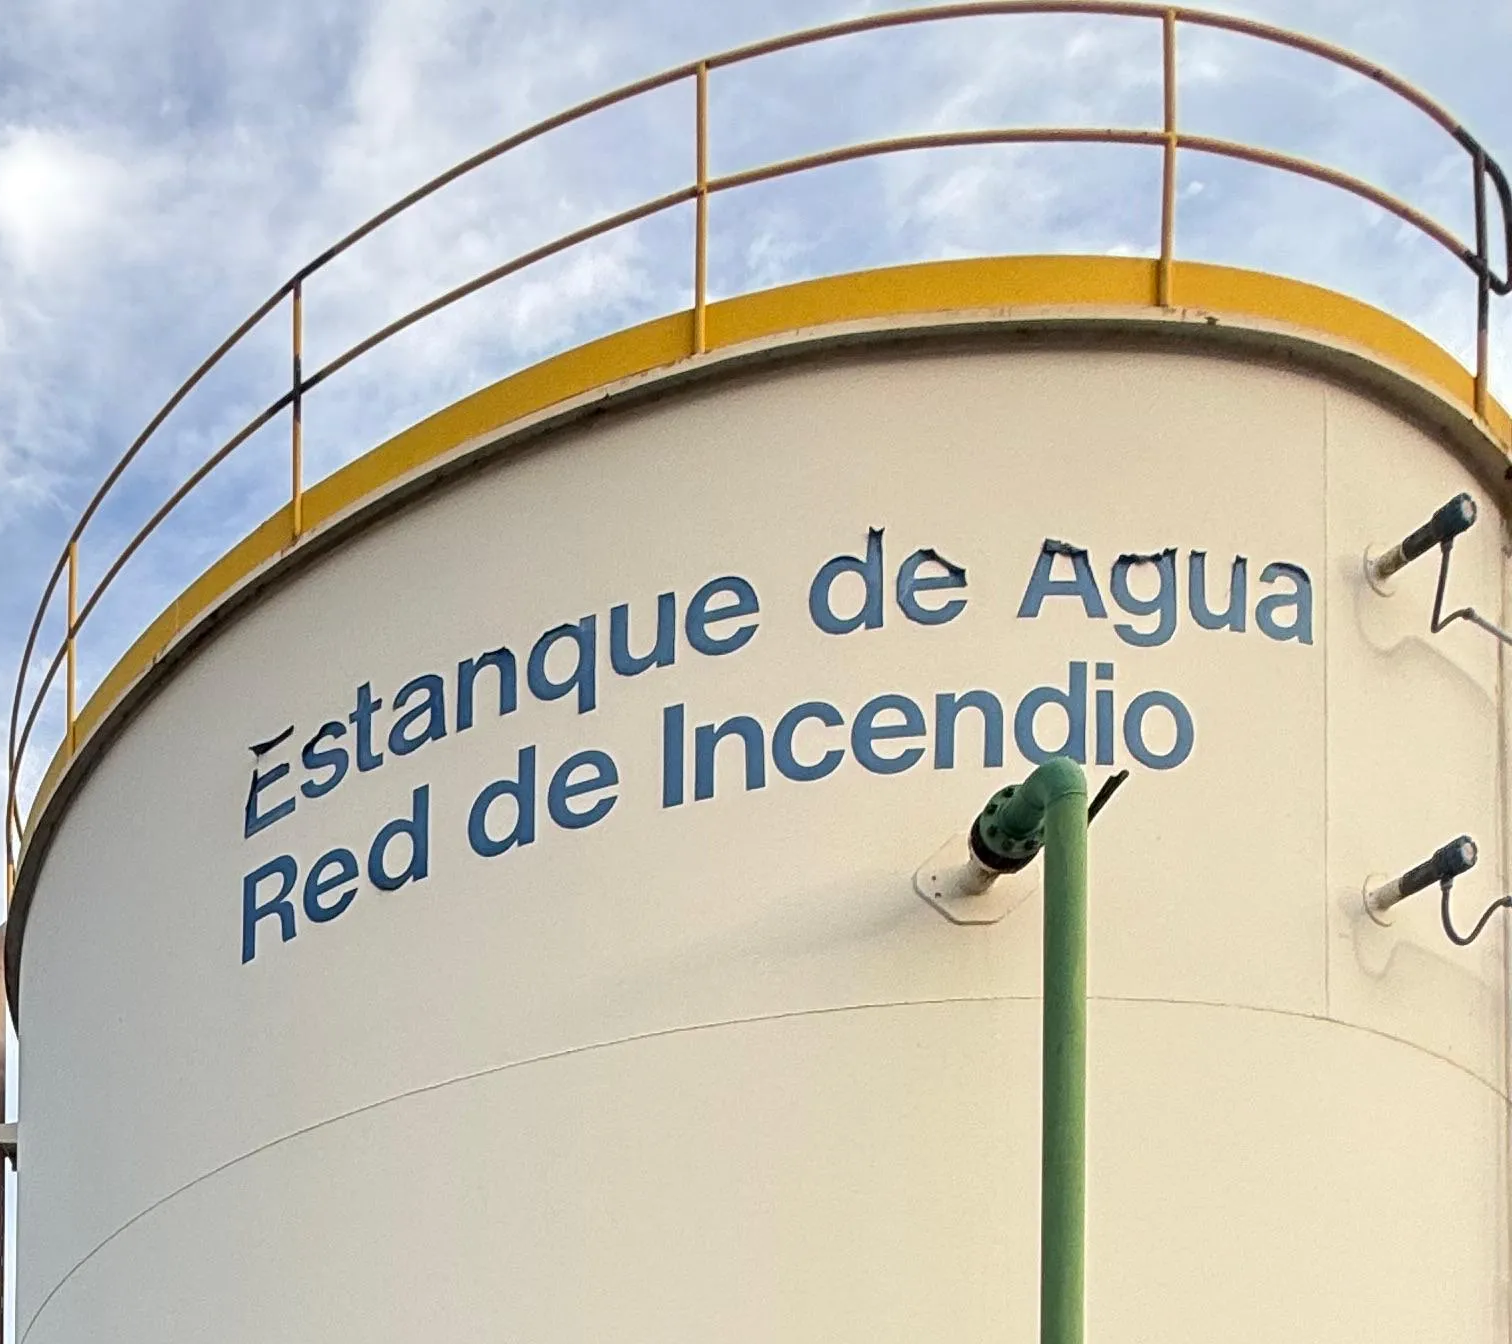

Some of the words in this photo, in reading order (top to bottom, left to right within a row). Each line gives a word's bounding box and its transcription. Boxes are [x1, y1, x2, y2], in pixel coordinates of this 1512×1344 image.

[240, 793, 430, 965] Red
[467, 746, 619, 860] de
[662, 661, 1195, 809] Incendio
[242, 575, 759, 839] Estanque
[810, 527, 967, 636] de
[1015, 538, 1313, 650] Agua
